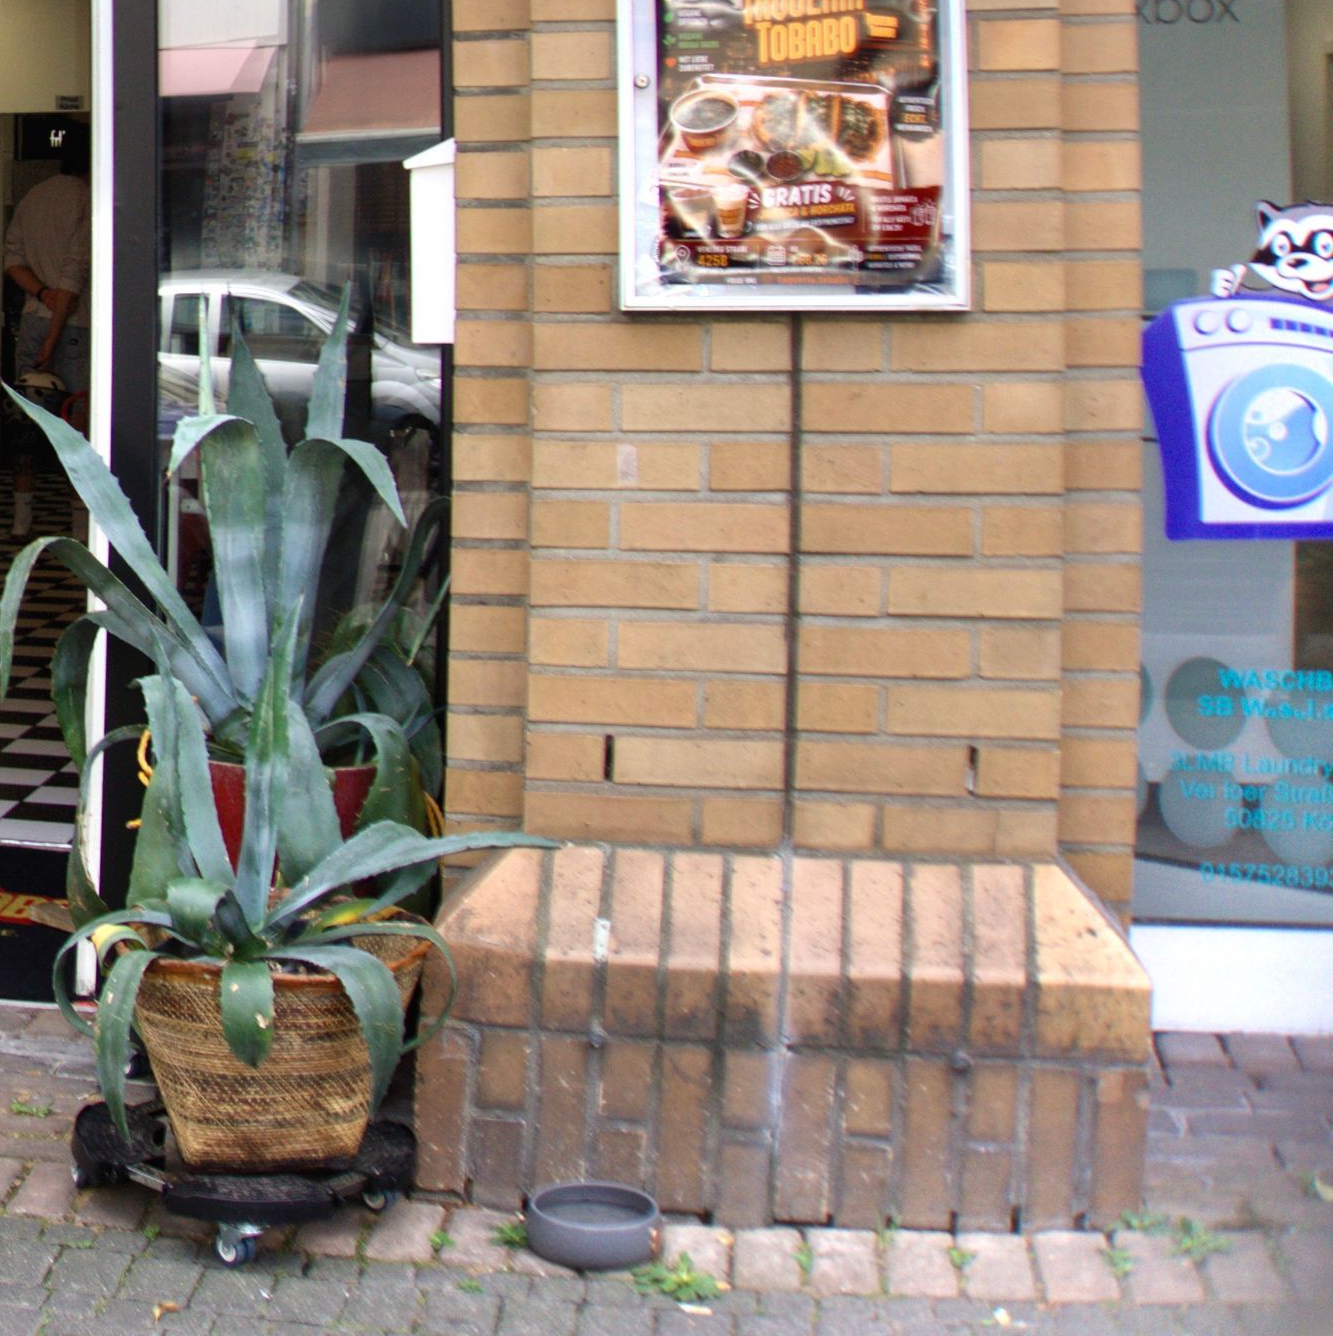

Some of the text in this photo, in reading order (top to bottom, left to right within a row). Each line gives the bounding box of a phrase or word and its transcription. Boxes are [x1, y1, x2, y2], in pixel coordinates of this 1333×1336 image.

[756, 15, 857, 64] TOBABO
[761, 183, 832, 208] GRATIS
[1197, 694, 1234, 718] SB
